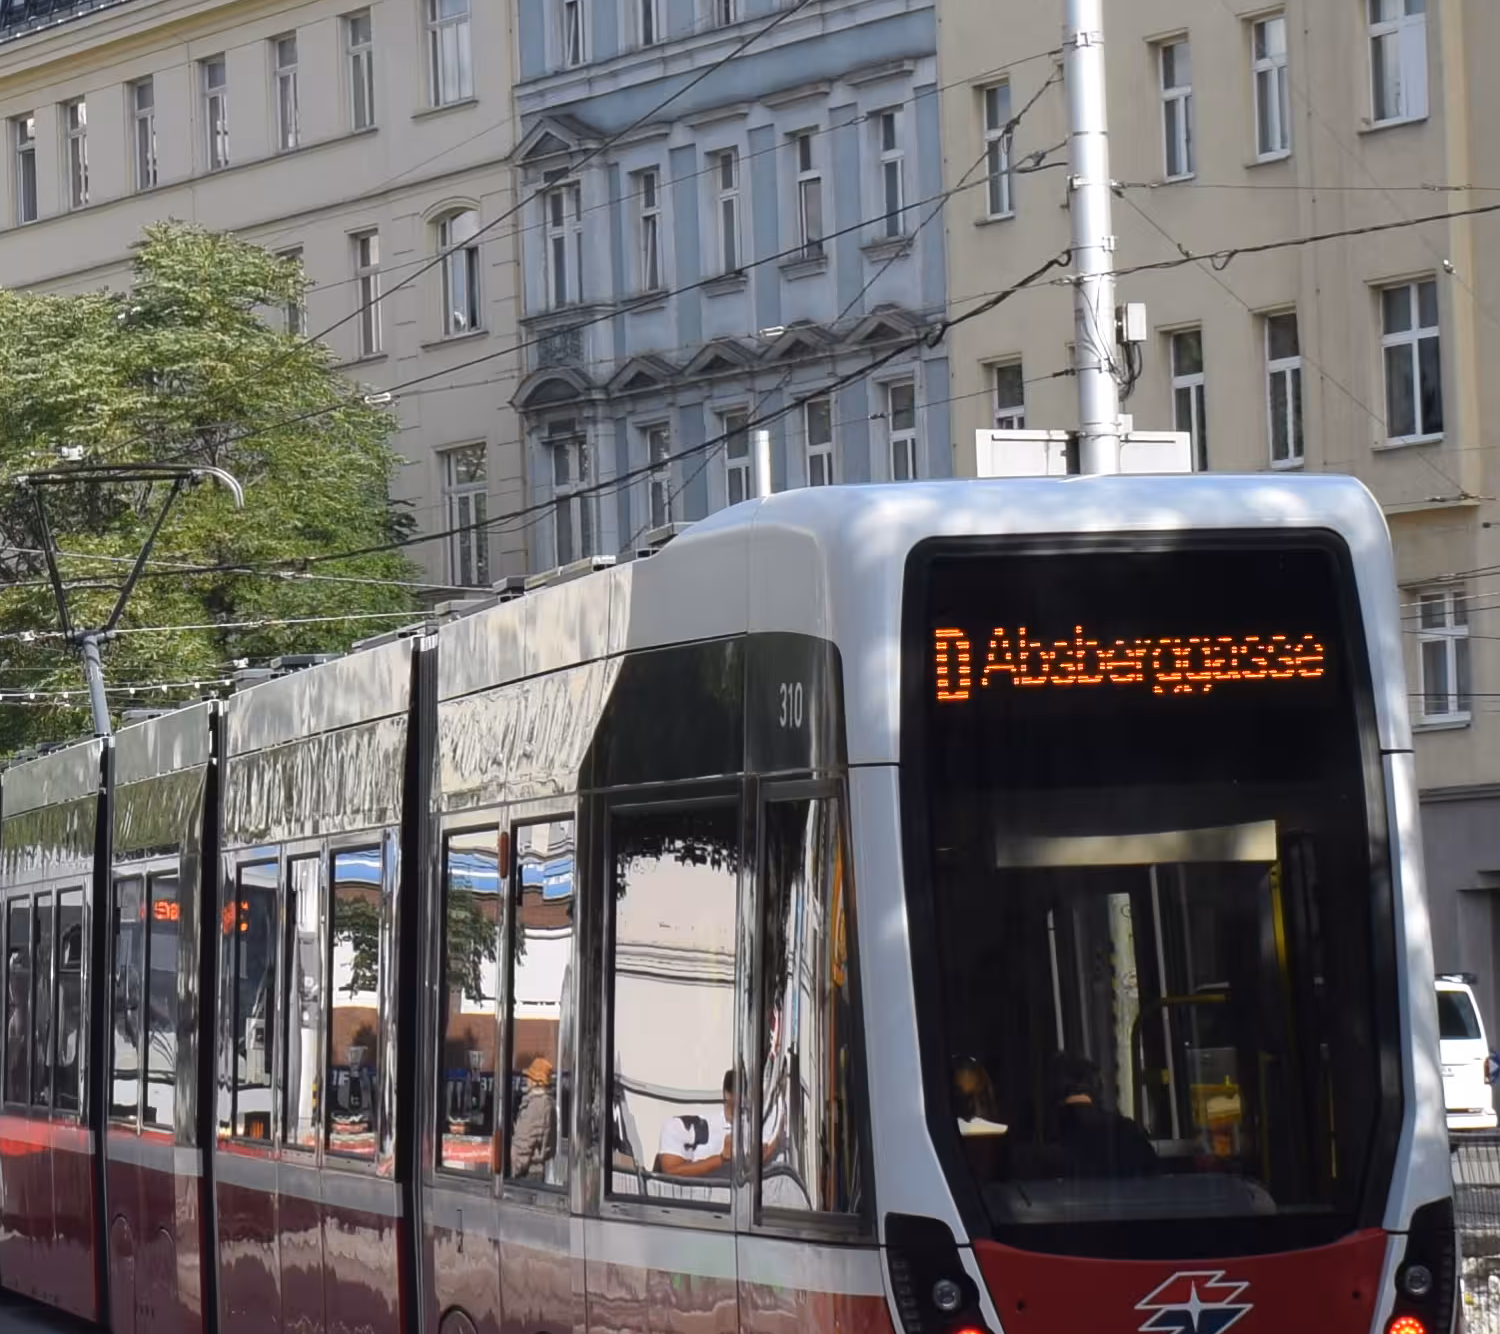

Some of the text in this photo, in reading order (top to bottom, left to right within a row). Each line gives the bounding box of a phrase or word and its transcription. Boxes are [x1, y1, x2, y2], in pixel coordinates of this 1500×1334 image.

[934, 624, 1325, 700] D Absberggasse
[779, 681, 803, 728] 310
